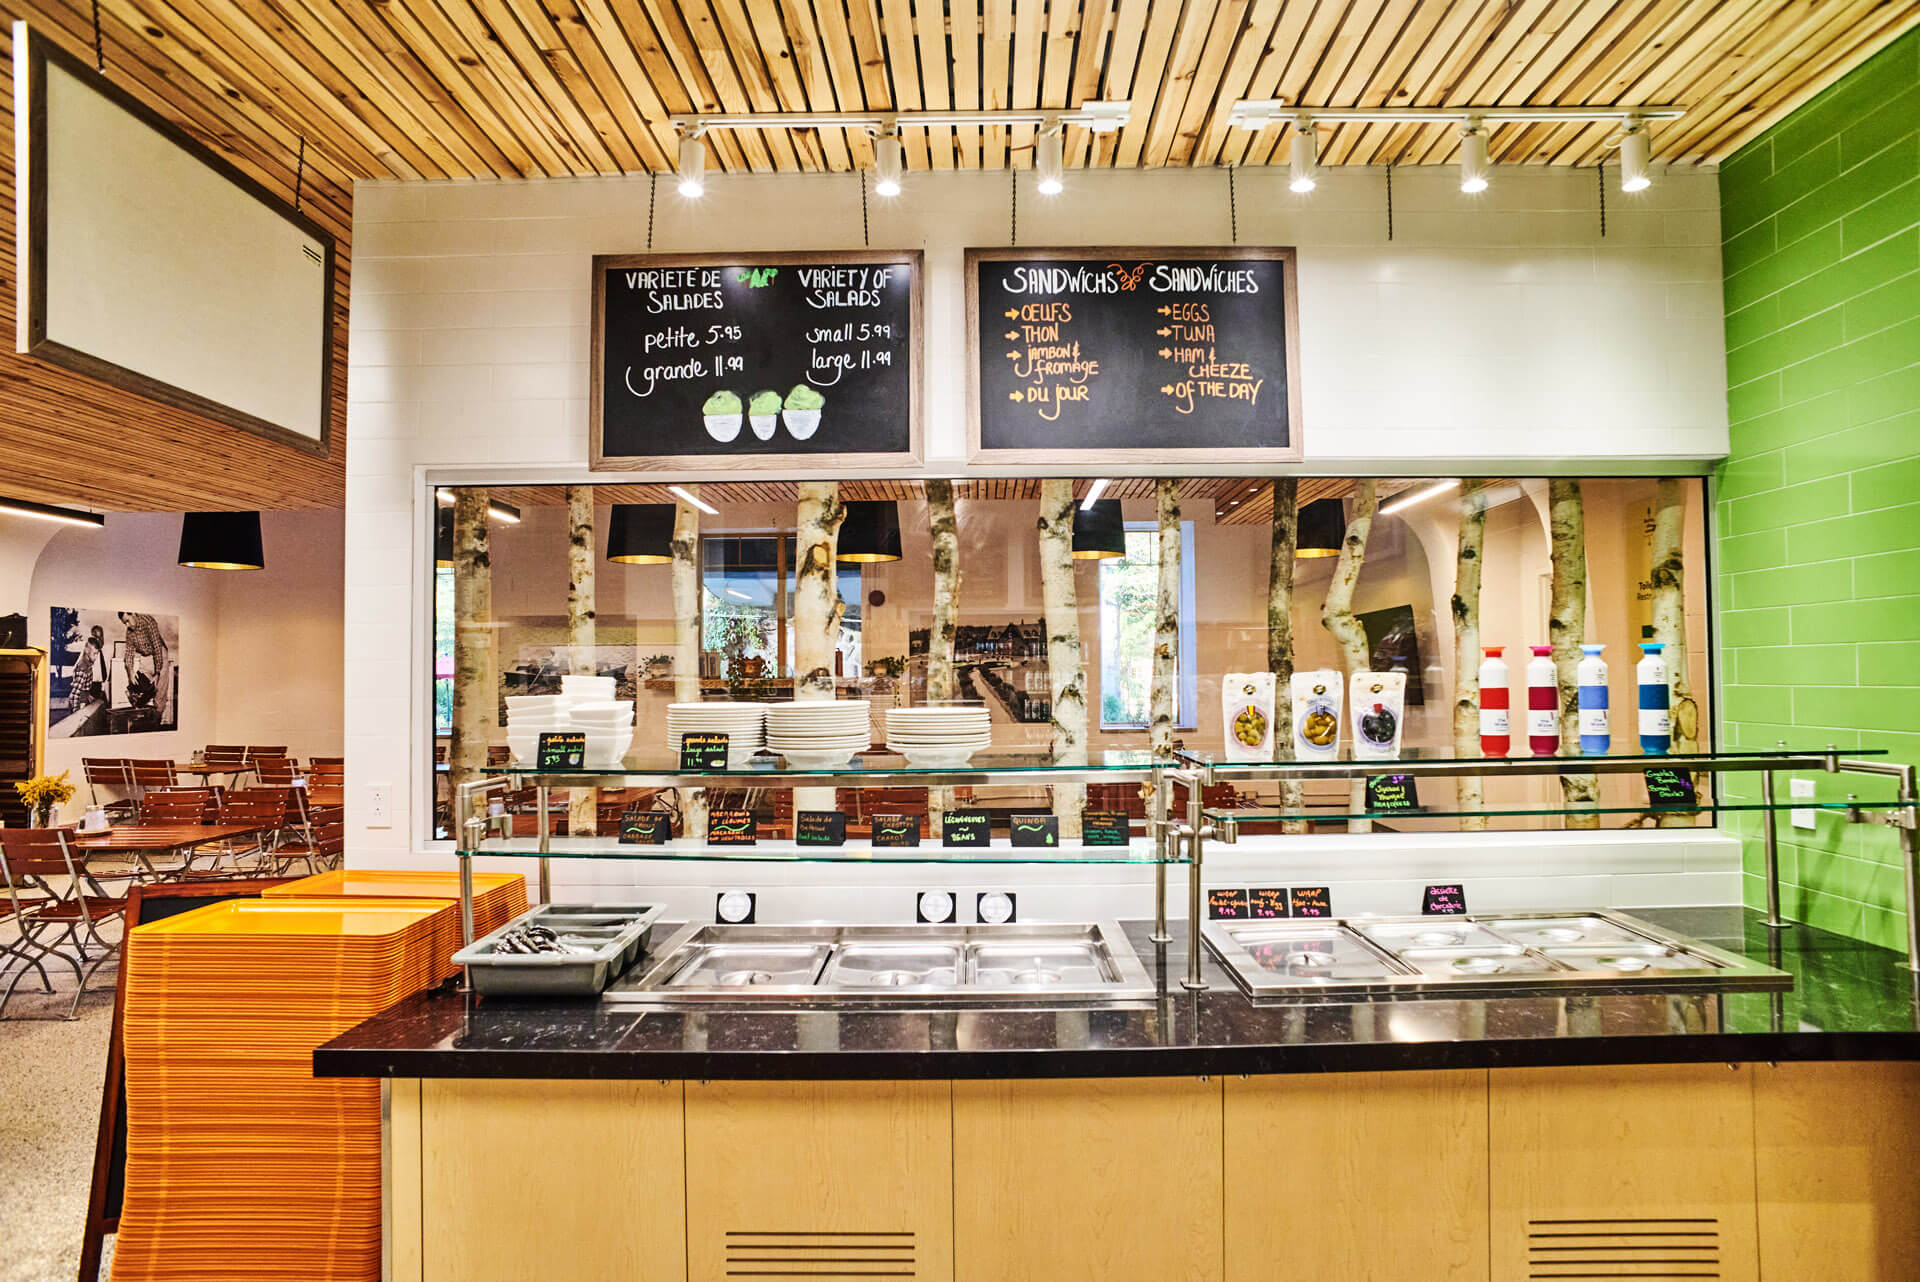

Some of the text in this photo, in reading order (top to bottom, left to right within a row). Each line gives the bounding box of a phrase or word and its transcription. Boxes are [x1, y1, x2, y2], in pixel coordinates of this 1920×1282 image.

[701, 269, 722, 289] DE
[872, 268, 894, 290] OF
[646, 290, 724, 314] SALADES
[805, 289, 881, 309] SALADS
[1172, 303, 1210, 322] EGGS
[644, 324, 743, 354] petite 5.95
[806, 322, 891, 344] small 5.99
[1020, 321, 1059, 343] THON
[1170, 324, 1216, 343] TUNA
[806, 346, 891, 386] large 11.99
[1173, 346, 1205, 364] HAM
[625, 354, 744, 397] grande 11.99
[1188, 362, 1254, 380] CHEEZE
[1027, 386, 1050, 403] DU
[1197, 381, 1227, 397] THE
[1229, 378, 1264, 406] DAY
